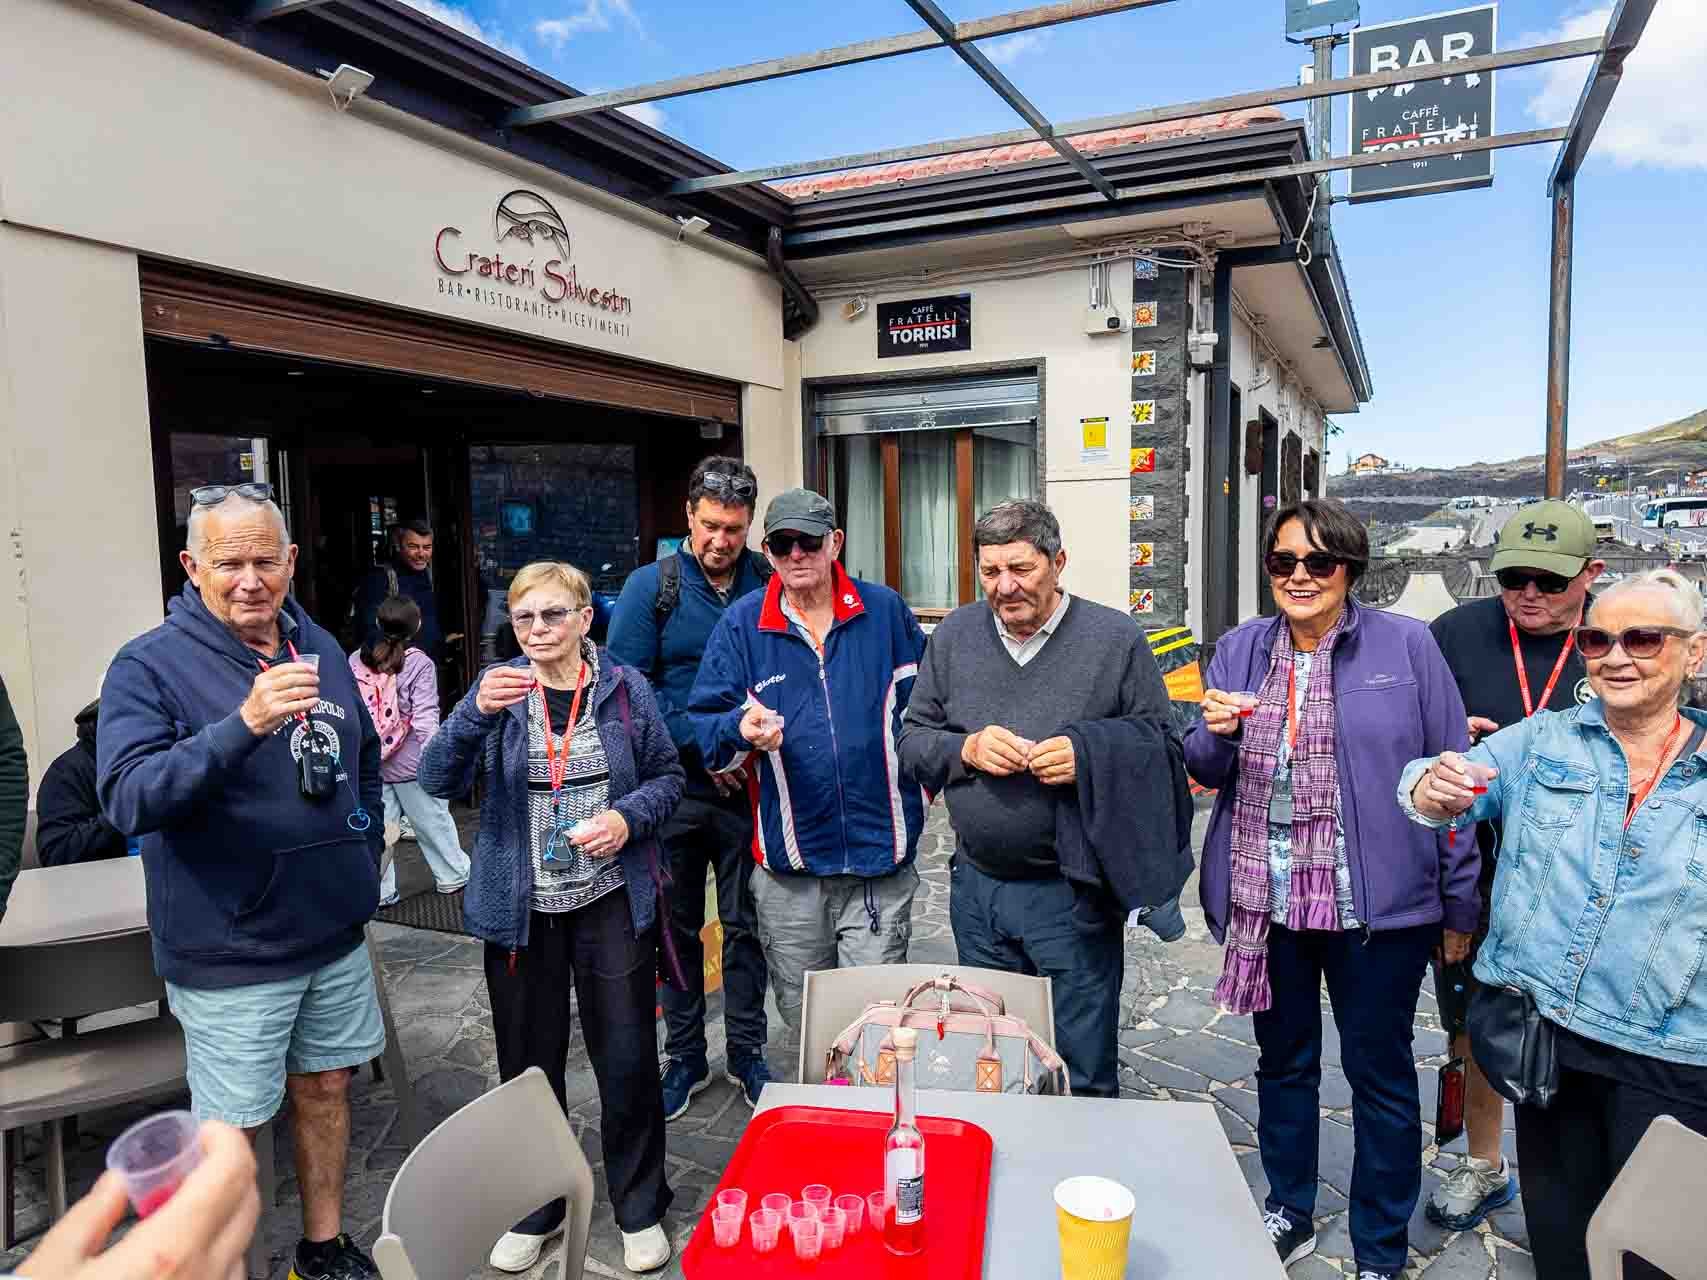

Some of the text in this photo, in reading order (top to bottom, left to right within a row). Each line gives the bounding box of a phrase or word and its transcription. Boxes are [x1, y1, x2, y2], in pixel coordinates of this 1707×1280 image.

[1368, 31, 1480, 102] BAR
[1402, 105, 1439, 120] CAFFÈ
[889, 312, 956, 326] FRATELLI
[889, 325, 957, 344] TORRISI
